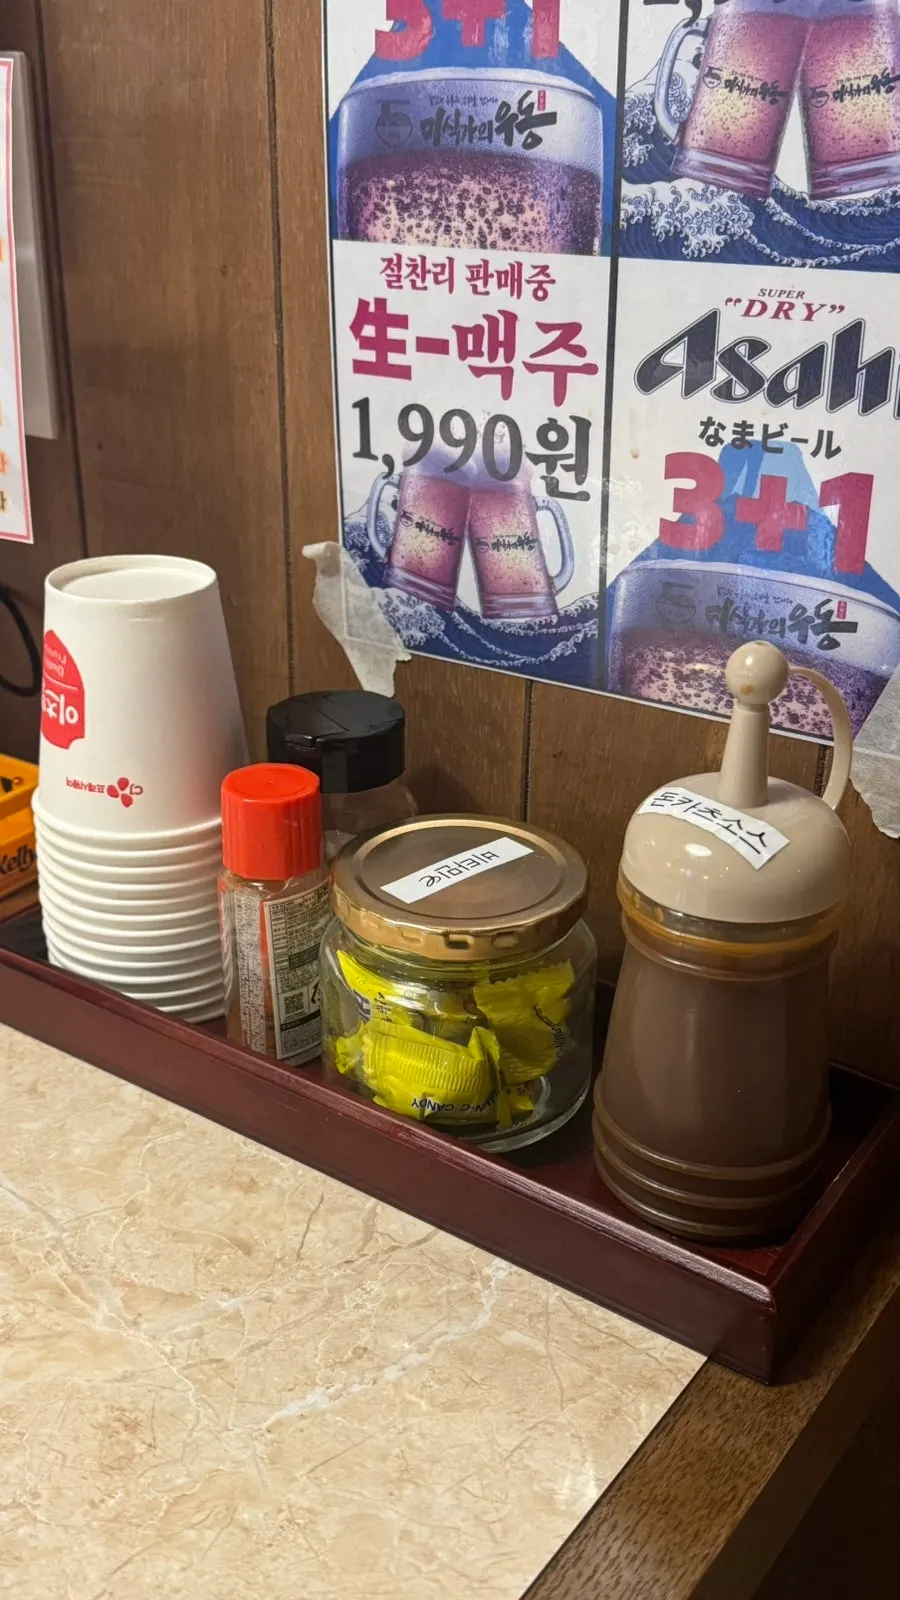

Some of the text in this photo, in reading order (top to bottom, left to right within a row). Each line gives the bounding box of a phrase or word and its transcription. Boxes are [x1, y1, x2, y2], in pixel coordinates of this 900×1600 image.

[378, 252, 556, 302] 절찬리 판매중
[757, 287, 806, 300] SUPER
[634, 308, 900, 420] Asah
[351, 396, 593, 502] 1,990원
[698, 416, 842, 459] なまビール
[658, 451, 875, 576] 3+1
[128, 783, 144, 796] CJ
[650, 792, 768, 855] 돈카츠소스
[411, 1097, 455, 1112] CANDY
